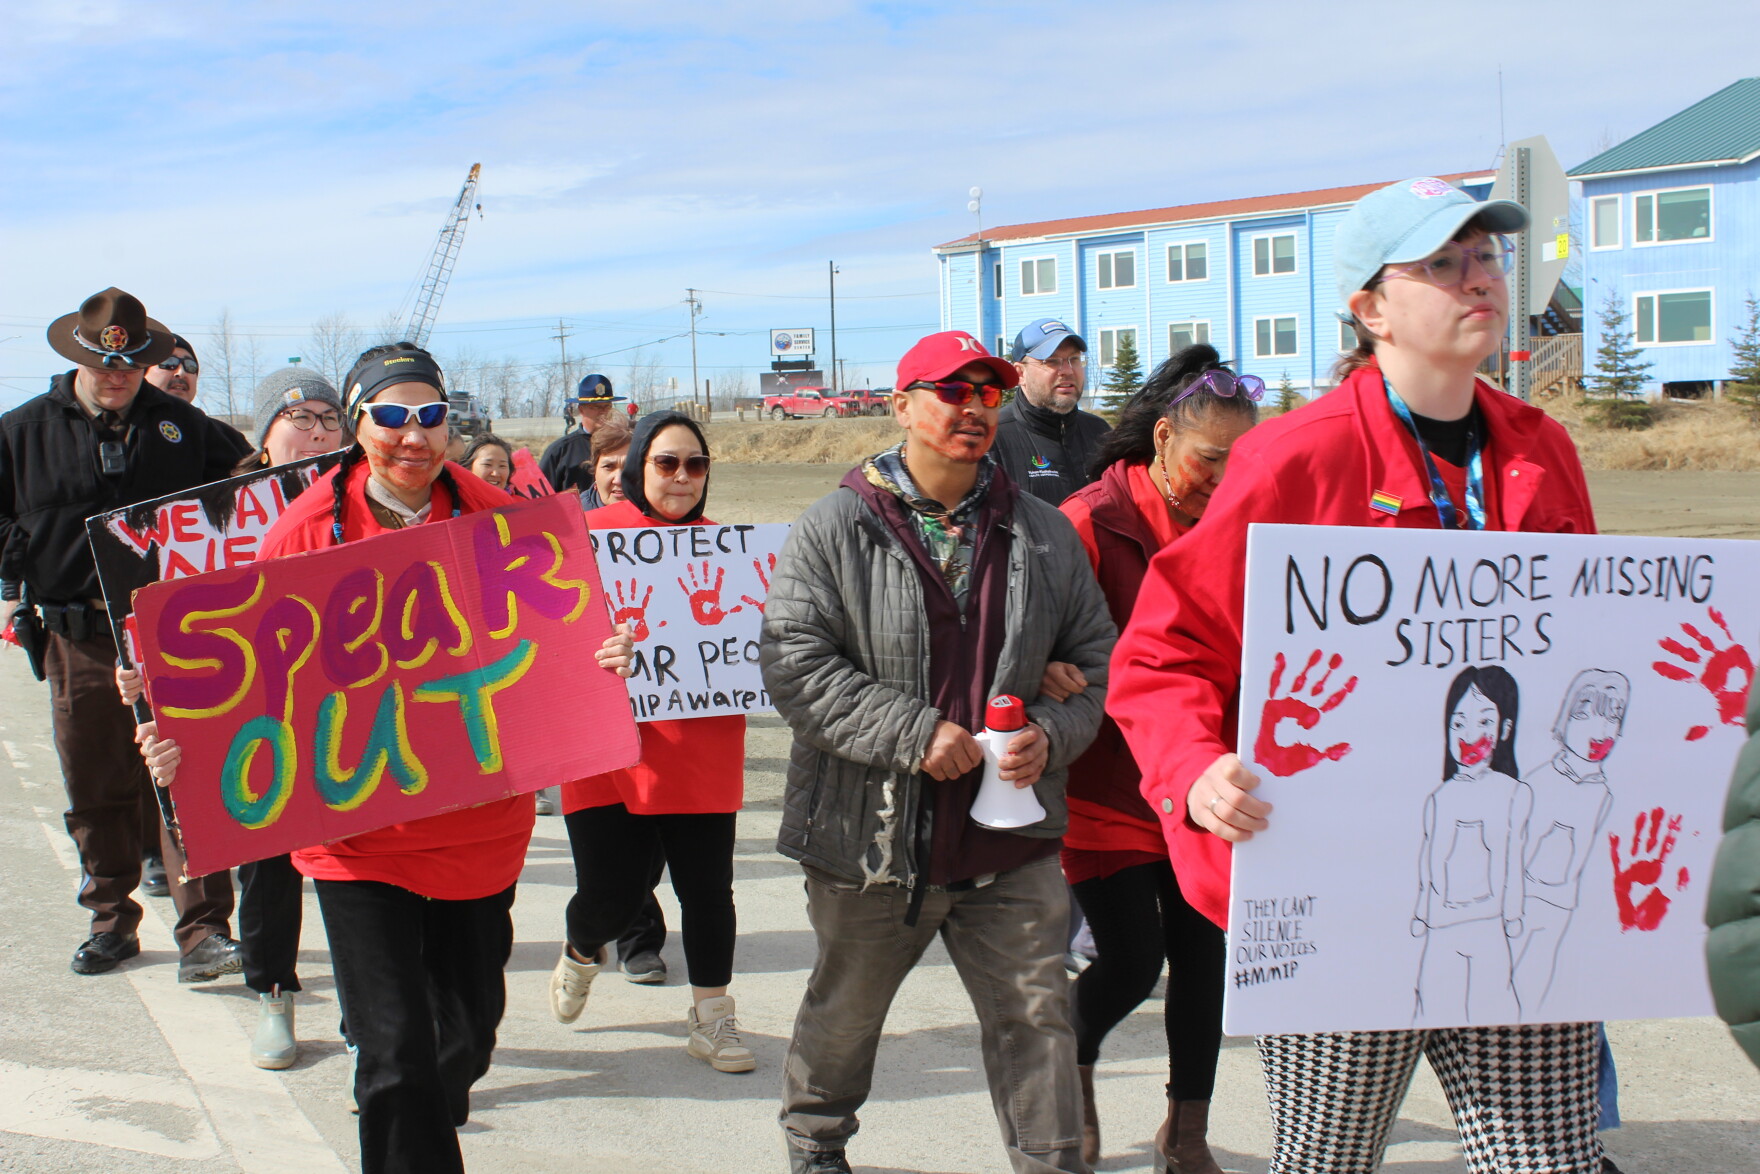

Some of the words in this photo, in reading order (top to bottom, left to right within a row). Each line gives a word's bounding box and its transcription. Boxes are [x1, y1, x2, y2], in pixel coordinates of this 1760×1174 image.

[117, 504, 205, 551] WE
[1286, 553, 1394, 634] NO
[1414, 553, 1552, 614] MORE
[1570, 553, 1715, 604] MISSING
[698, 636, 761, 689] PEO
[1386, 611, 1552, 669] SISTERS
[1241, 919, 1303, 942] SILENCE
[1243, 898, 1277, 919] THEY
[1236, 943, 1267, 965] OUR
